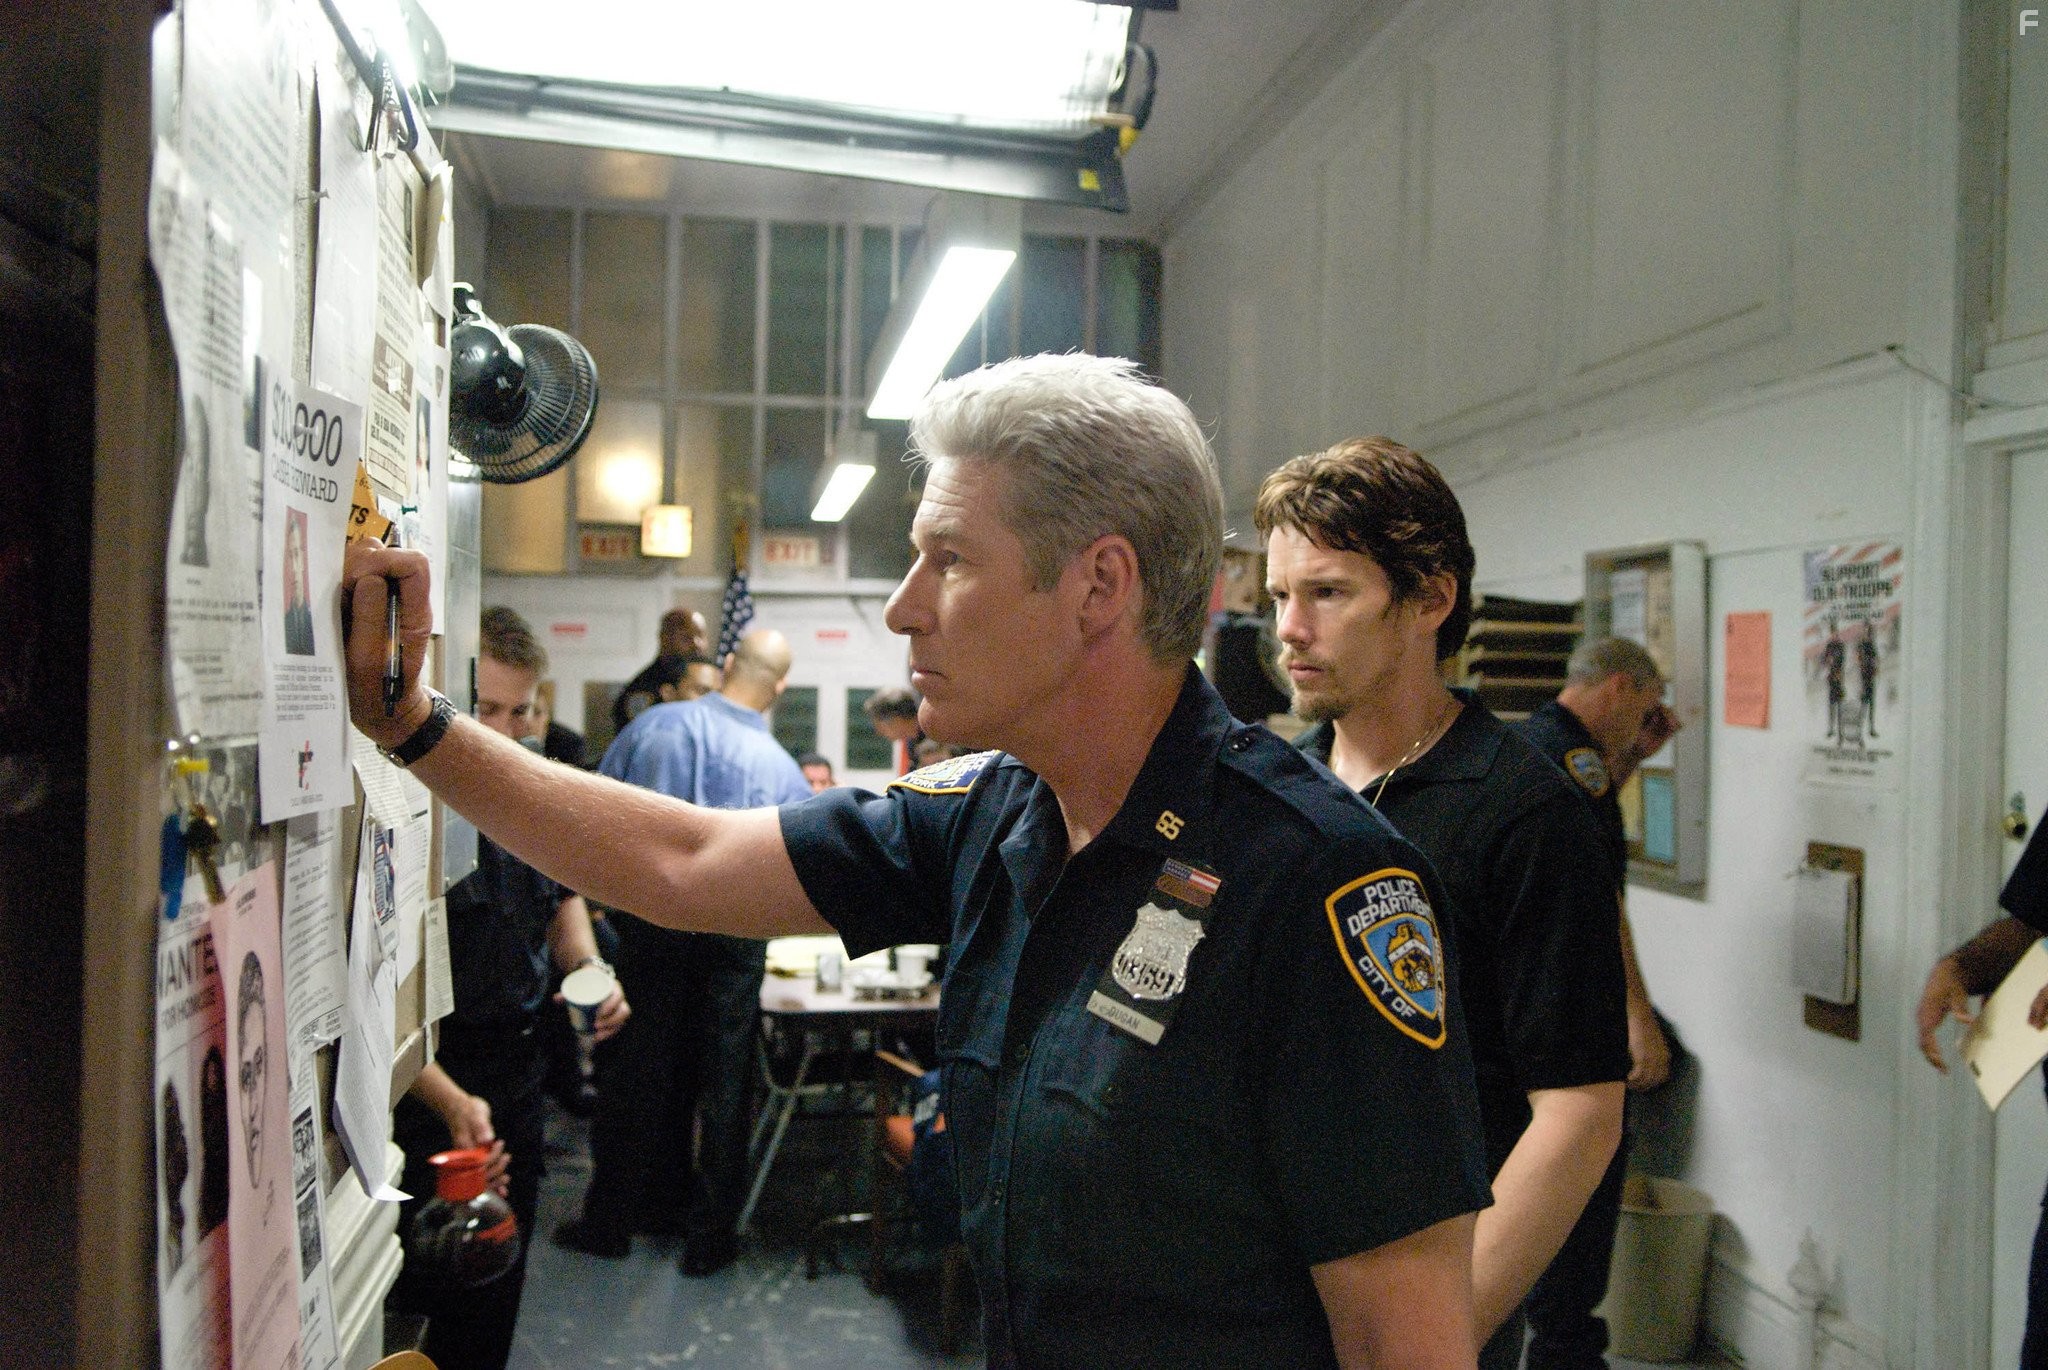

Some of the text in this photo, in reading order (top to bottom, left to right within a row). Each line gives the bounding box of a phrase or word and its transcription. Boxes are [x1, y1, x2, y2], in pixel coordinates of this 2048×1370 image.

[291, 466, 338, 502] REWARD
[1363, 879, 1418, 904] POLICE
[1358, 955, 1416, 1018] CITY OF
